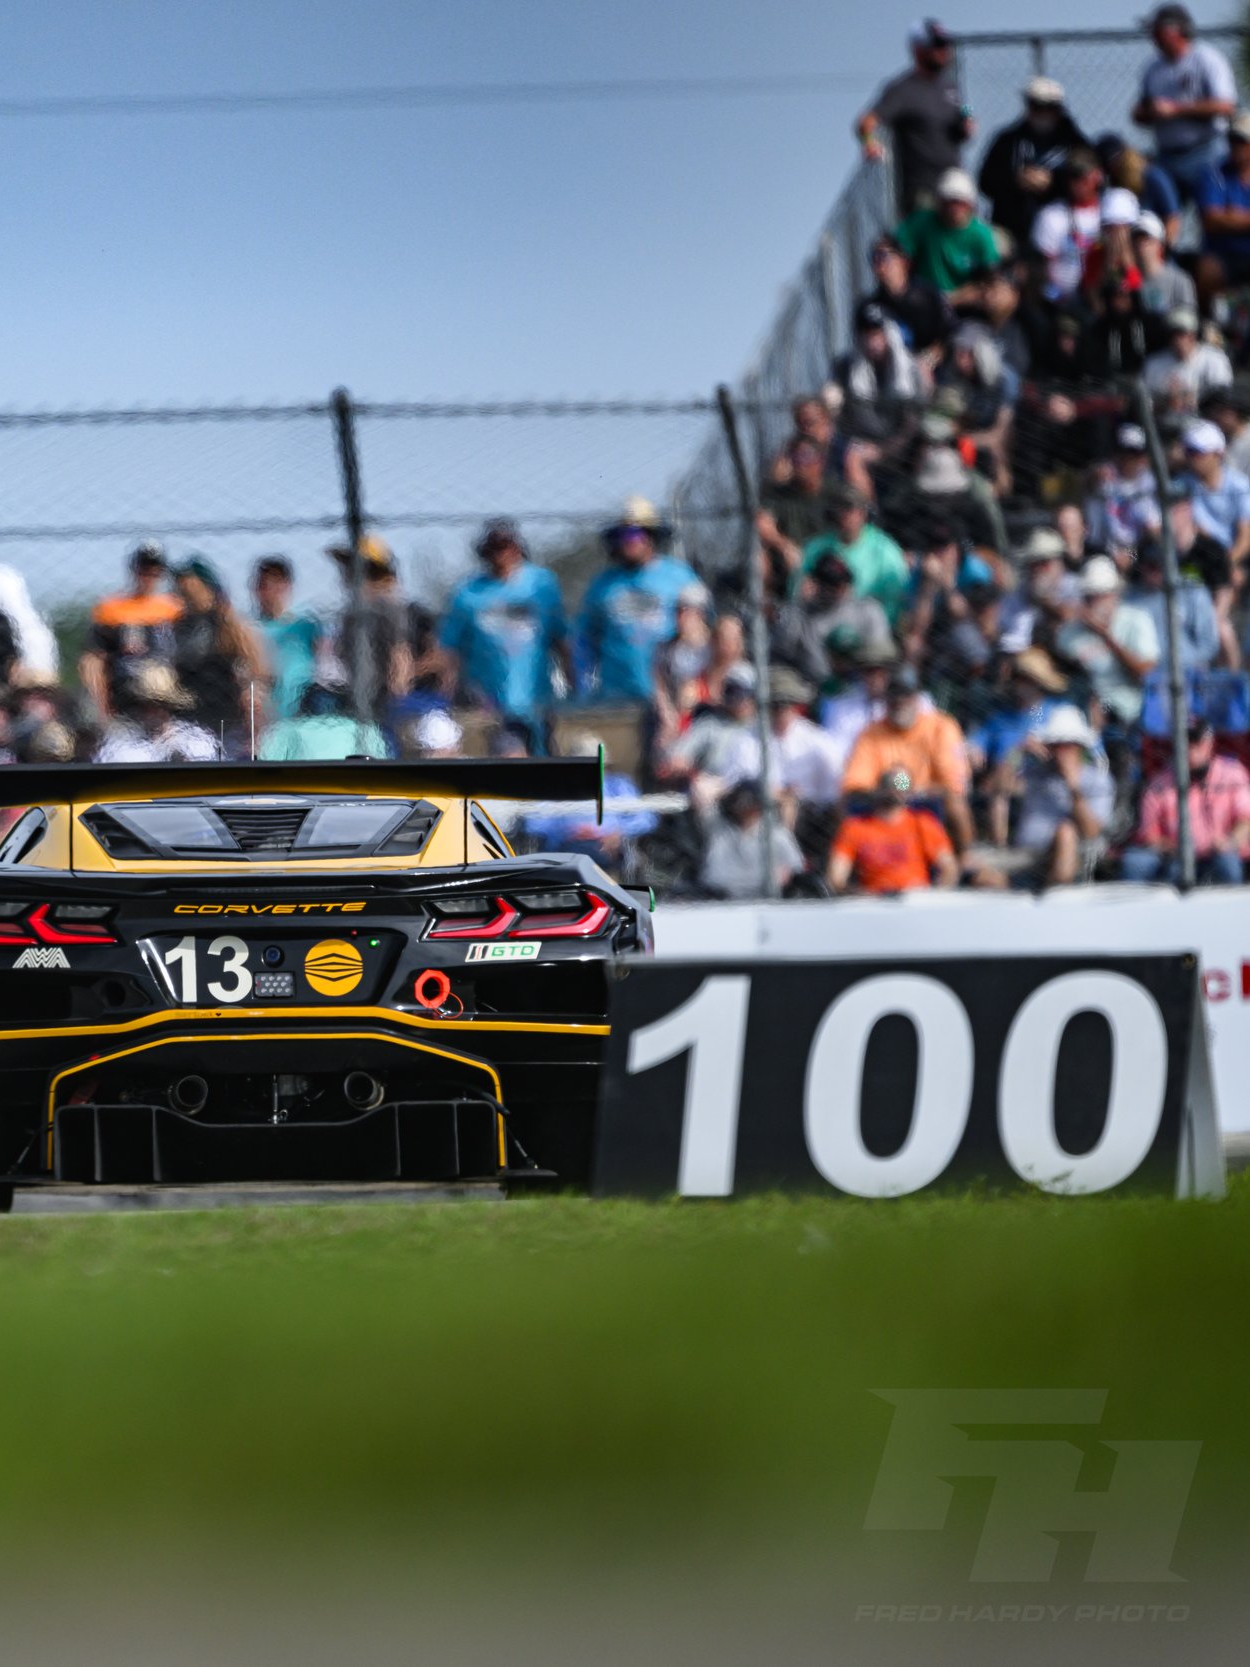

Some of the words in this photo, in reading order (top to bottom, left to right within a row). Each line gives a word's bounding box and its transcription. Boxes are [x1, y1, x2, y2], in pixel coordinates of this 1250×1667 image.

[174, 902, 367, 914] CORVETTE
[12, 947, 71, 968] AWA
[491, 945, 535, 957] GTD
[165, 935, 253, 1003] 13
[626, 969, 1169, 1198] 100
